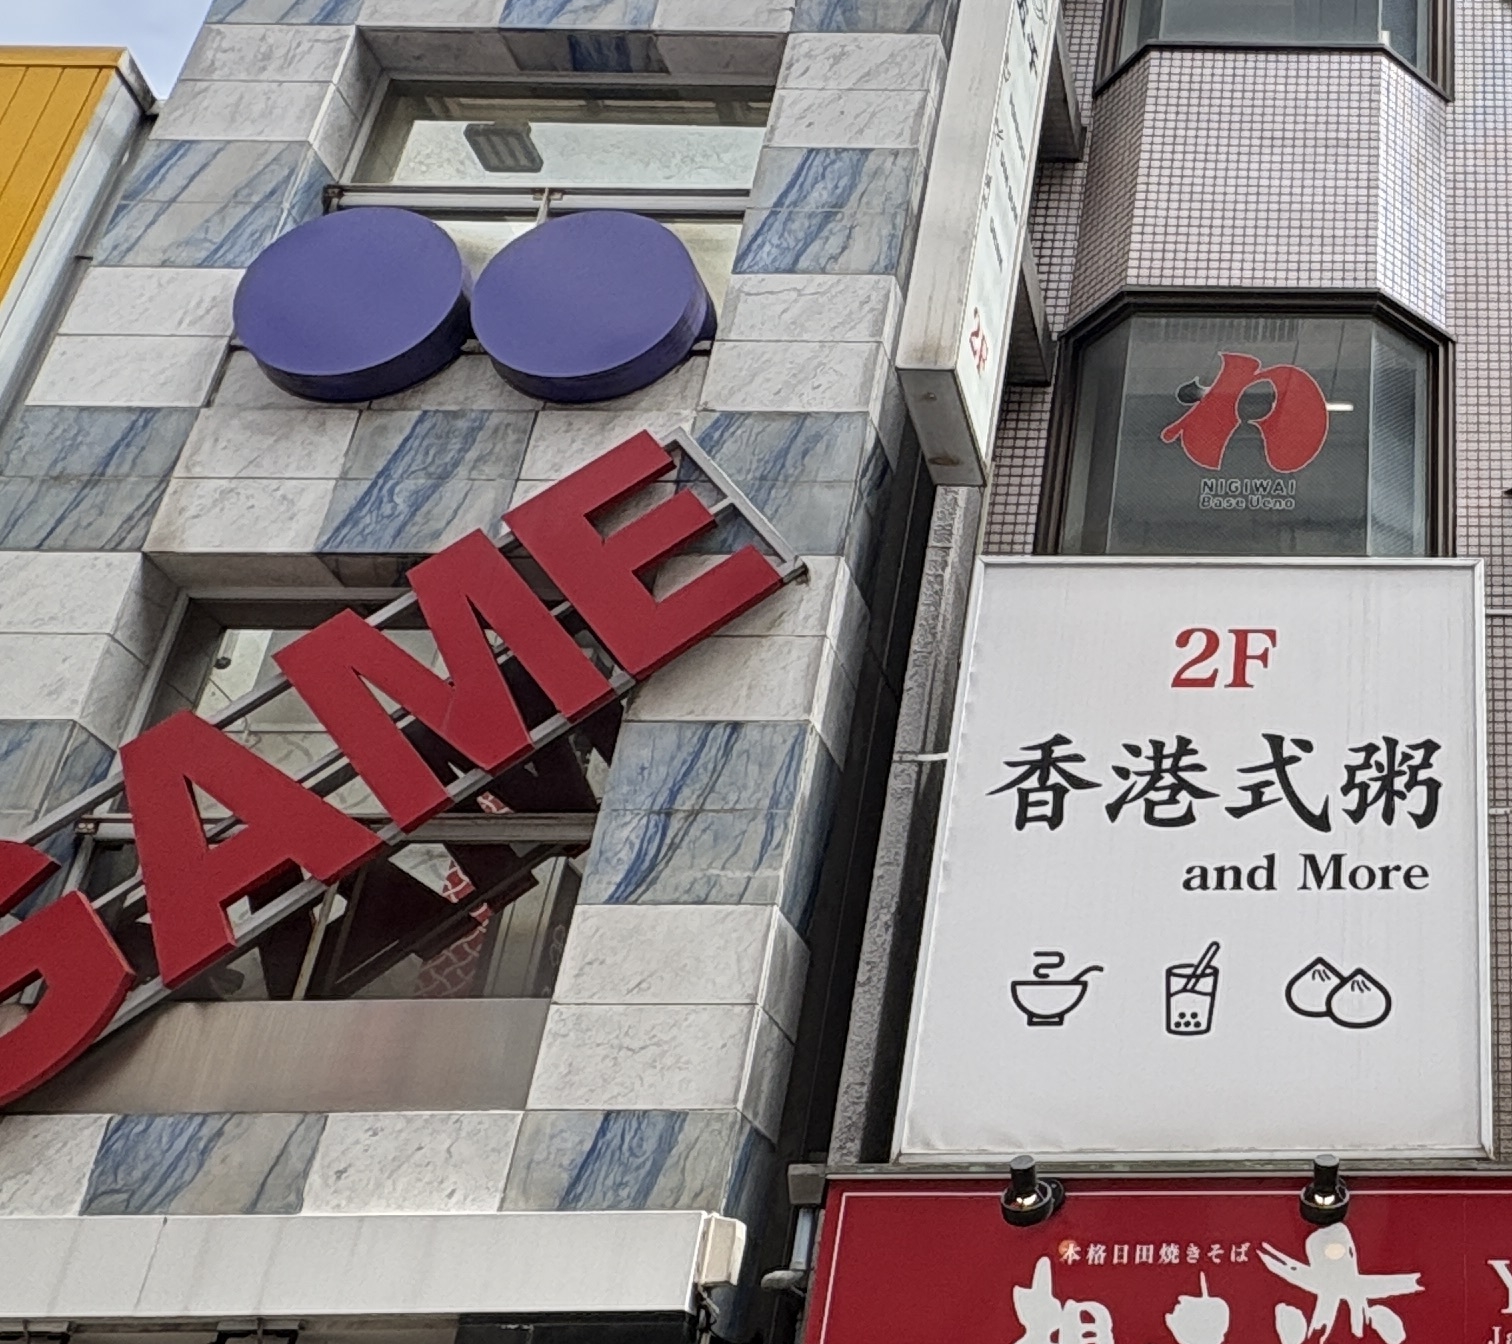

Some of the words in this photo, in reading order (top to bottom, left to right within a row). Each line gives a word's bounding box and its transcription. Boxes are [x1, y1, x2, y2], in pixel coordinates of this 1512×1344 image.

[1199, 494, 1246, 510] Base
[1248, 494, 1296, 510] Ueno
[1200, 478, 1297, 495] NIGIWAI
[1171, 627, 1278, 689] 2F
[985, 733, 1443, 833] 香港式粥
[1182, 853, 1277, 892] and
[1298, 853, 1431, 892] More
[1061, 1240, 1252, 1266] 本格日田焼きそば
